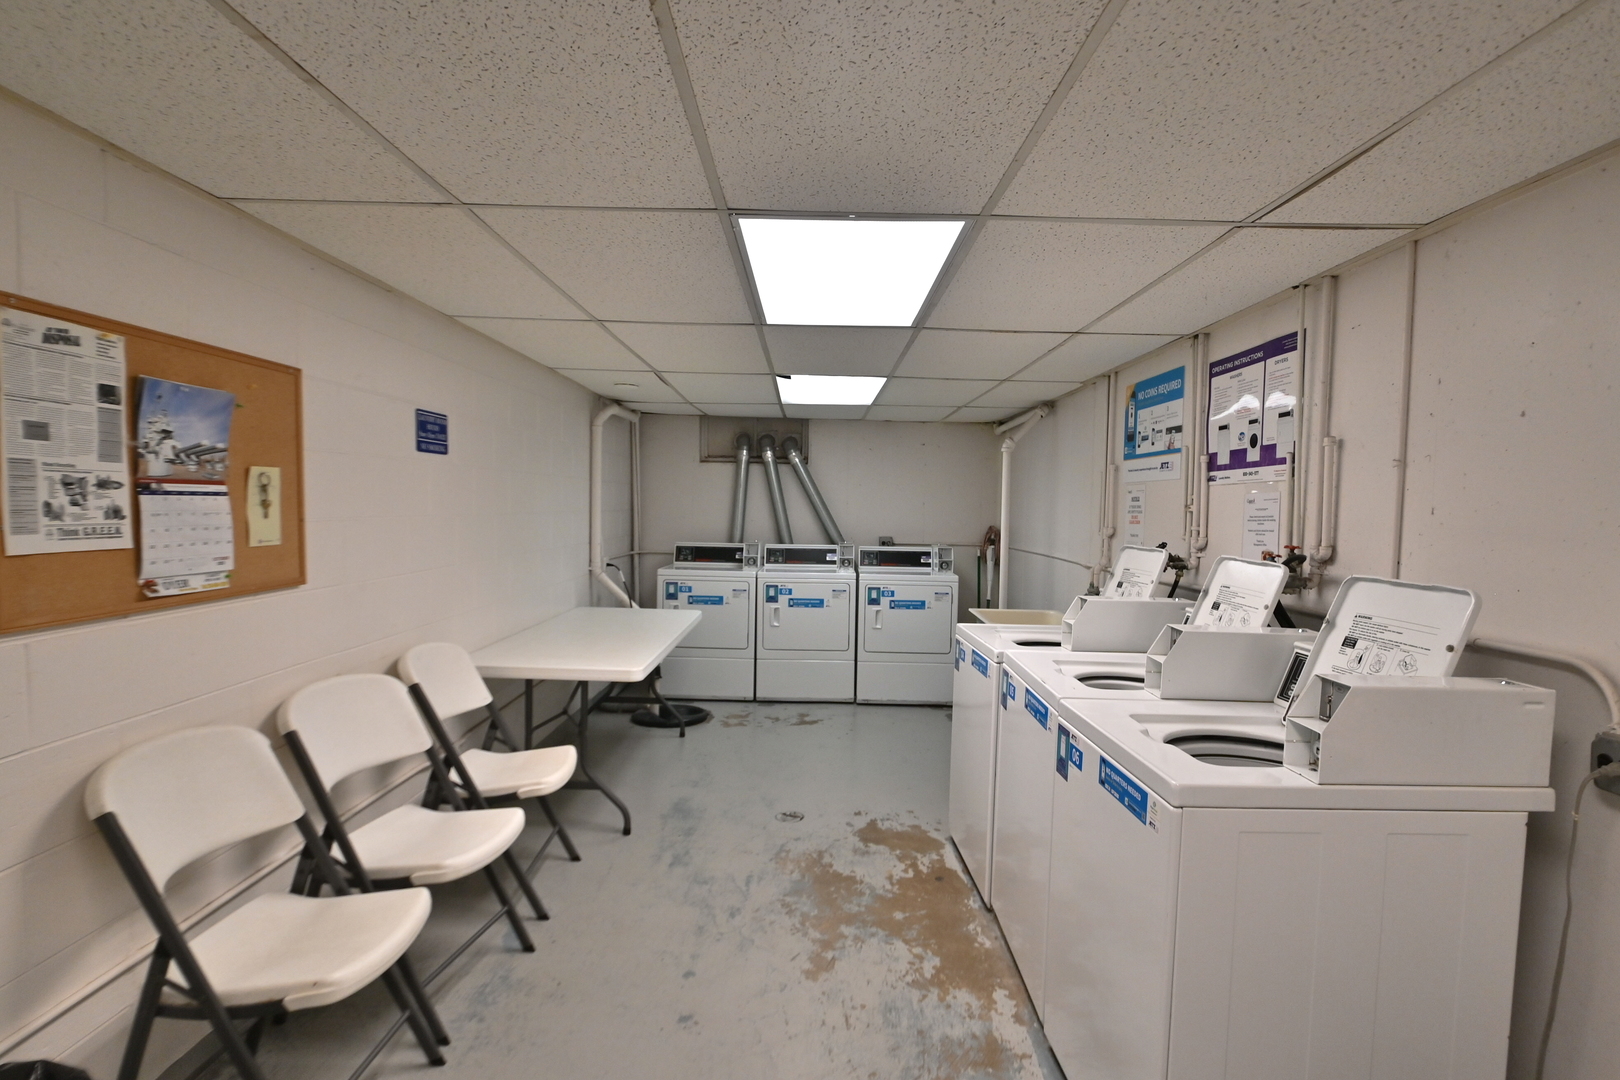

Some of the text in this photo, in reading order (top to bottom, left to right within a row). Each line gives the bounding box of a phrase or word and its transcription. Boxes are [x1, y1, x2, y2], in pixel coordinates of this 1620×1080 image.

[1212, 351, 1264, 373] OPERATING INSTRUCTIONS
[1274, 357, 1288, 365] DRYERS
[1138, 379, 1181, 400] NO COINS REQUIRED
[1072, 749, 1079, 764] 06
